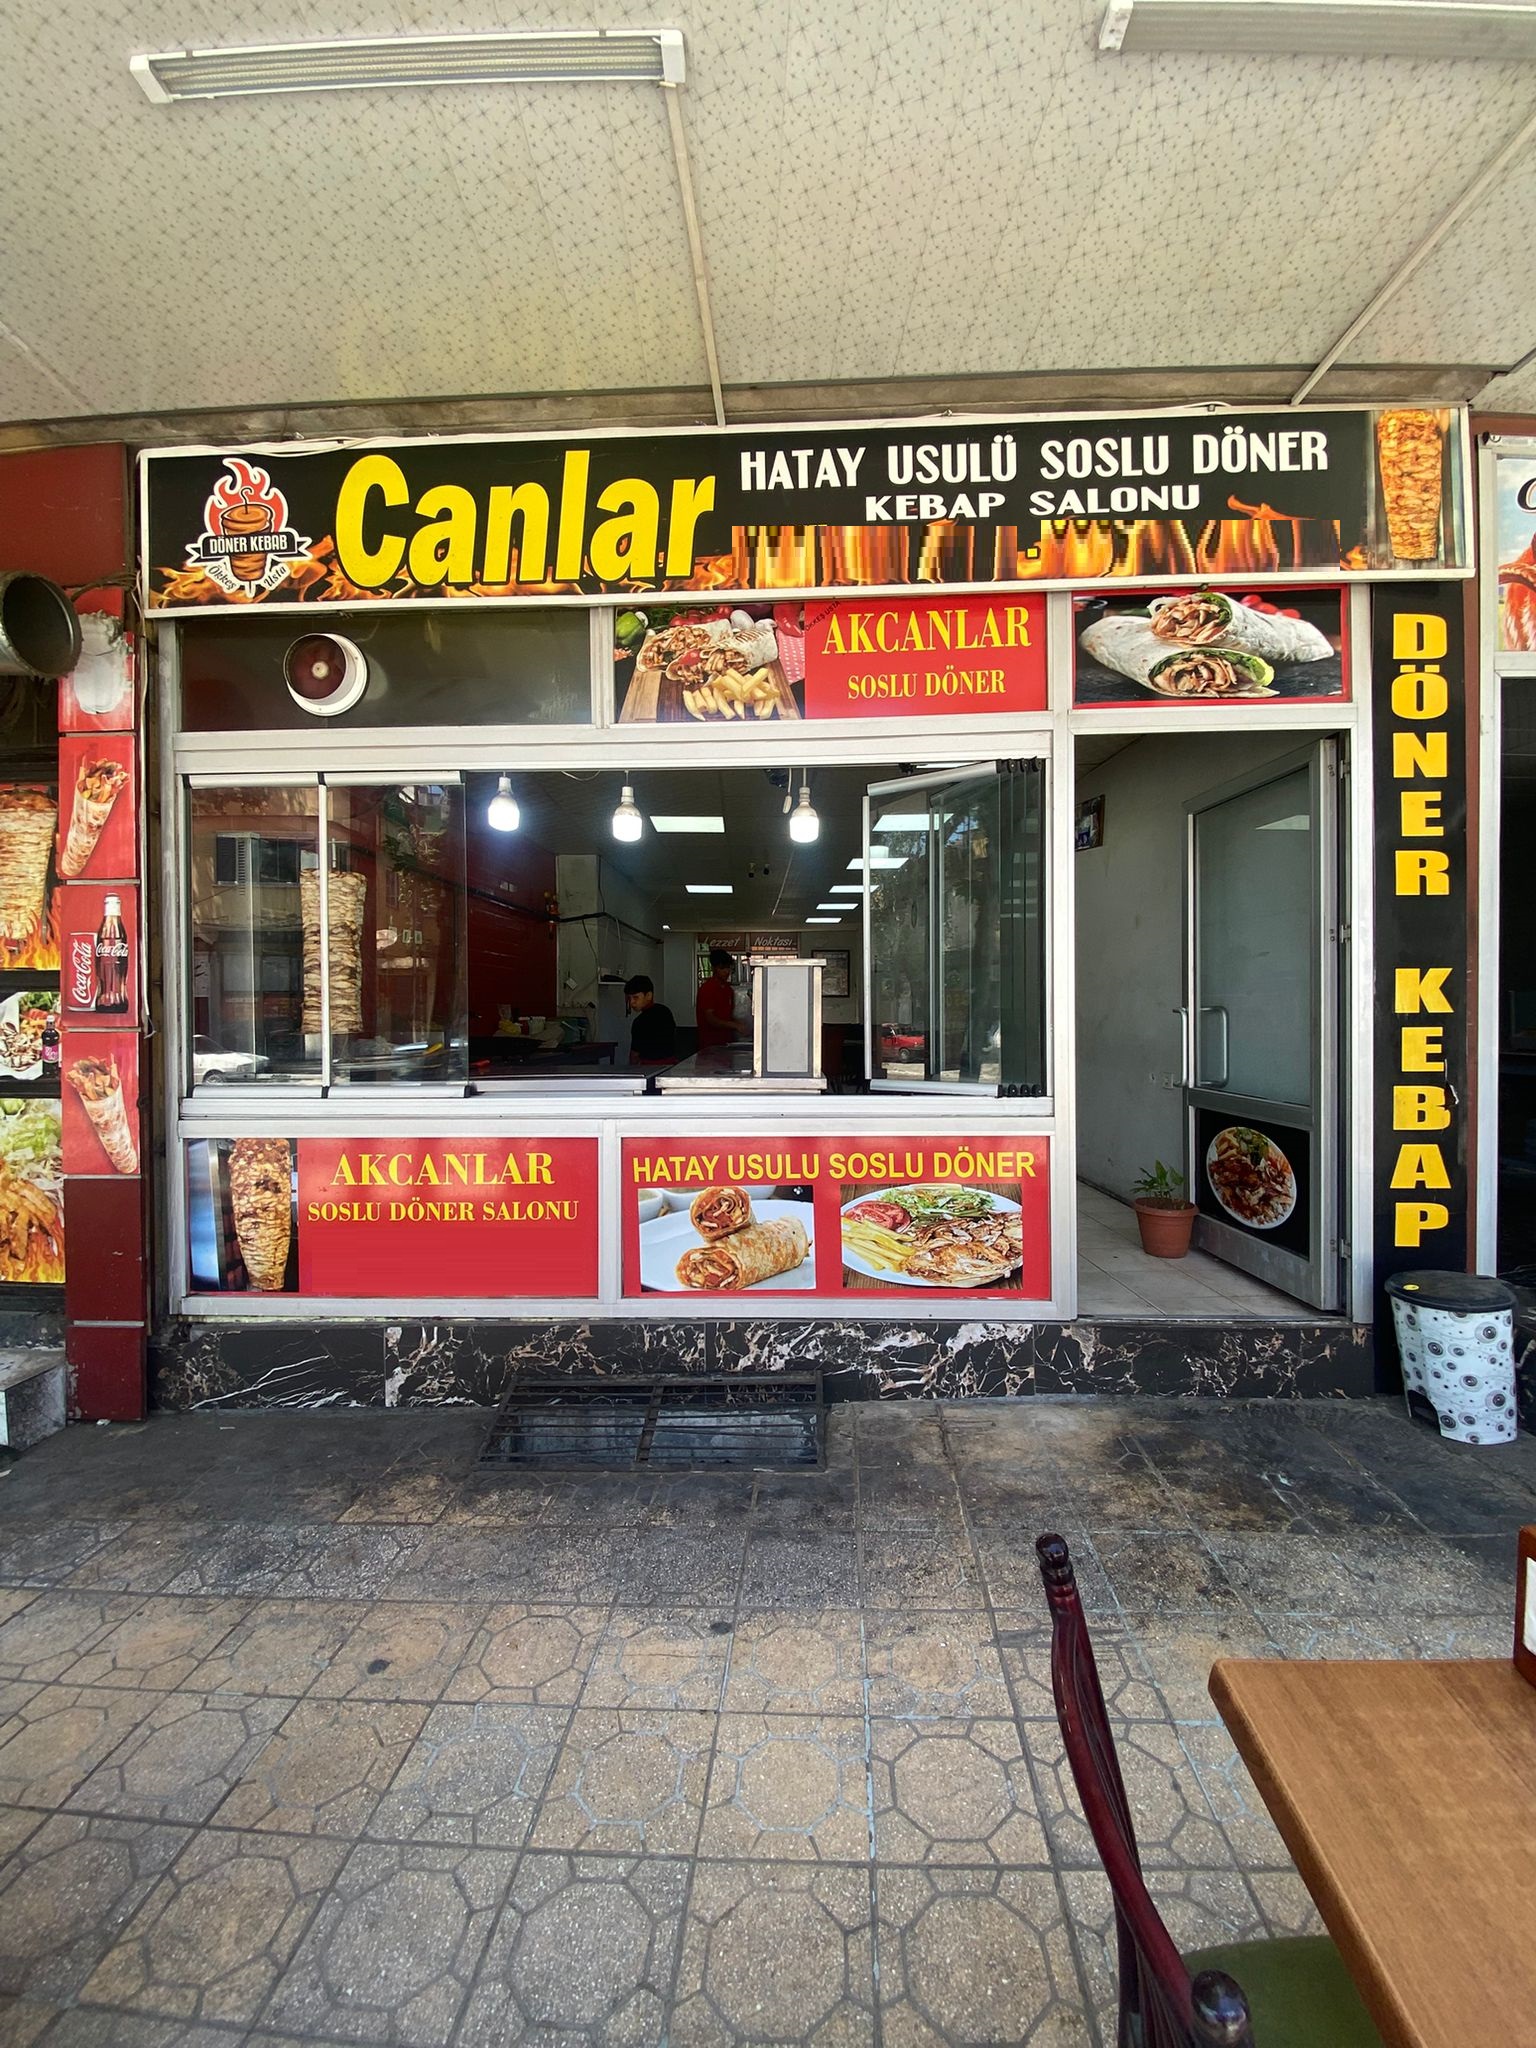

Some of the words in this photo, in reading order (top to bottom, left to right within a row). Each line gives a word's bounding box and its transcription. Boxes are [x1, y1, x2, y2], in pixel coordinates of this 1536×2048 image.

[740, 447, 866, 491] HATAY
[888, 434, 1017, 485] USULÜ
[1040, 435, 1169, 480] SOSLU
[1193, 425, 1328, 475] DÖNER
[335, 449, 716, 589] Canlar
[865, 492, 1006, 521] KEBAP
[1029, 484, 1200, 516] SALONU
[209, 536, 247, 554] DÖNER
[251, 534, 287, 551] KEBAB
[263, 565, 287, 587] Usta
[821, 606, 1032, 655] AKCANLAR
[848, 673, 918, 700] SOSLU
[925, 664, 1006, 697] DÖNER
[1391, 613, 1450, 896] DÖNER
[1389, 967, 1455, 1248] KEBAP
[330, 1152, 555, 1187] AKCANLAR
[632, 1154, 719, 1183] HATAY
[726, 1153, 820, 1180] USULU
[829, 1151, 924, 1179] SOSLU
[933, 1146, 1037, 1178] DÖNER
[307, 1201, 381, 1222] SOSLU
[388, 1197, 476, 1222] DÖNER
[482, 1200, 580, 1221] SALONU
